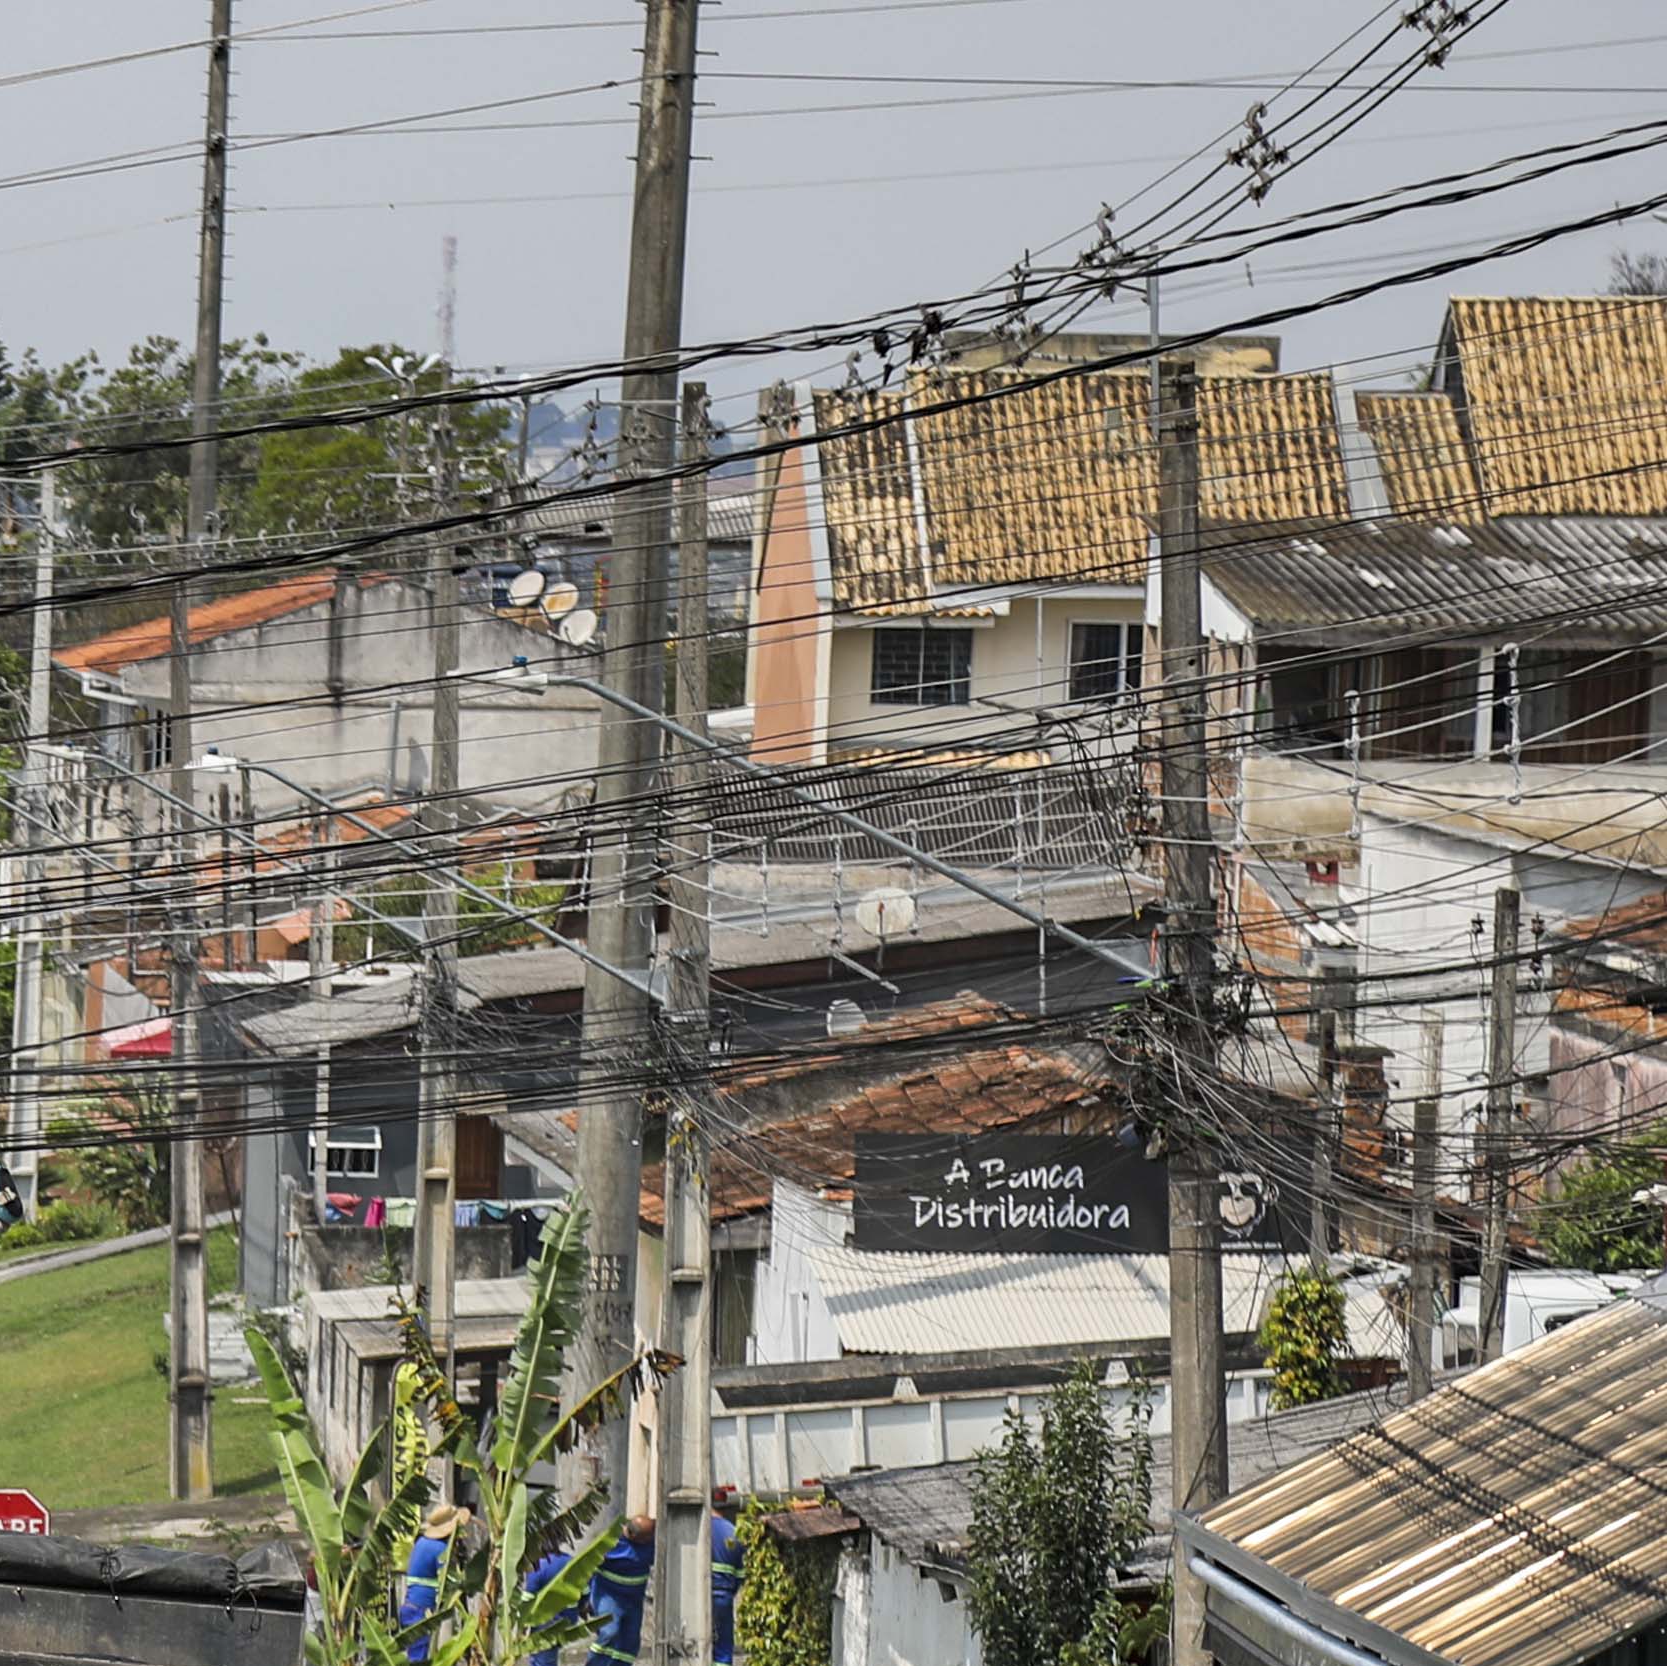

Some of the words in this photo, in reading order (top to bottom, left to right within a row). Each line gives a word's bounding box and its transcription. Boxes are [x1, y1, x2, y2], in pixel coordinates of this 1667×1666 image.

[944, 1157, 971, 1193] A
[979, 1157, 1084, 1190] Banca
[908, 1193, 1131, 1229] Distribuidora
